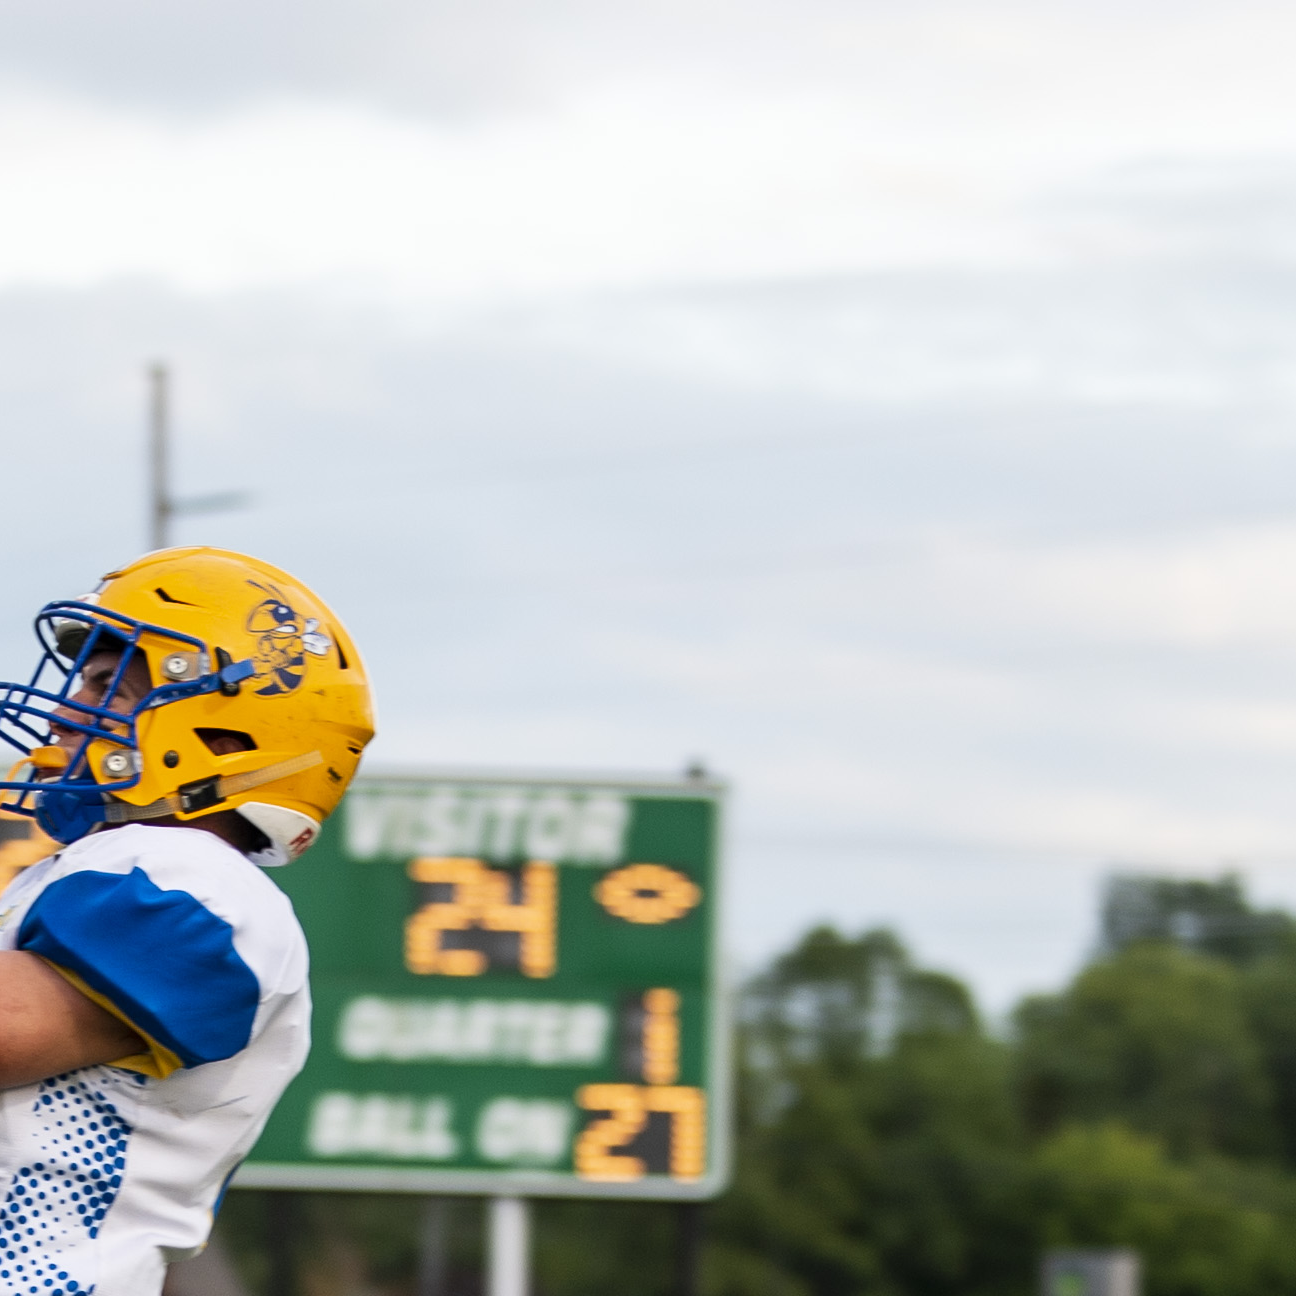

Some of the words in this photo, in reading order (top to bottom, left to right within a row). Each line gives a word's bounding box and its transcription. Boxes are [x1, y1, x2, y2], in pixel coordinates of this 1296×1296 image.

[343, 790, 630, 864] VISITOR
[406, 857, 557, 978] 24
[339, 997, 611, 1066] QUARTER
[641, 988, 680, 1086] 1
[307, 1091, 458, 1159] BALL
[475, 1099, 574, 1163] ON
[575, 1083, 707, 1184] 27
